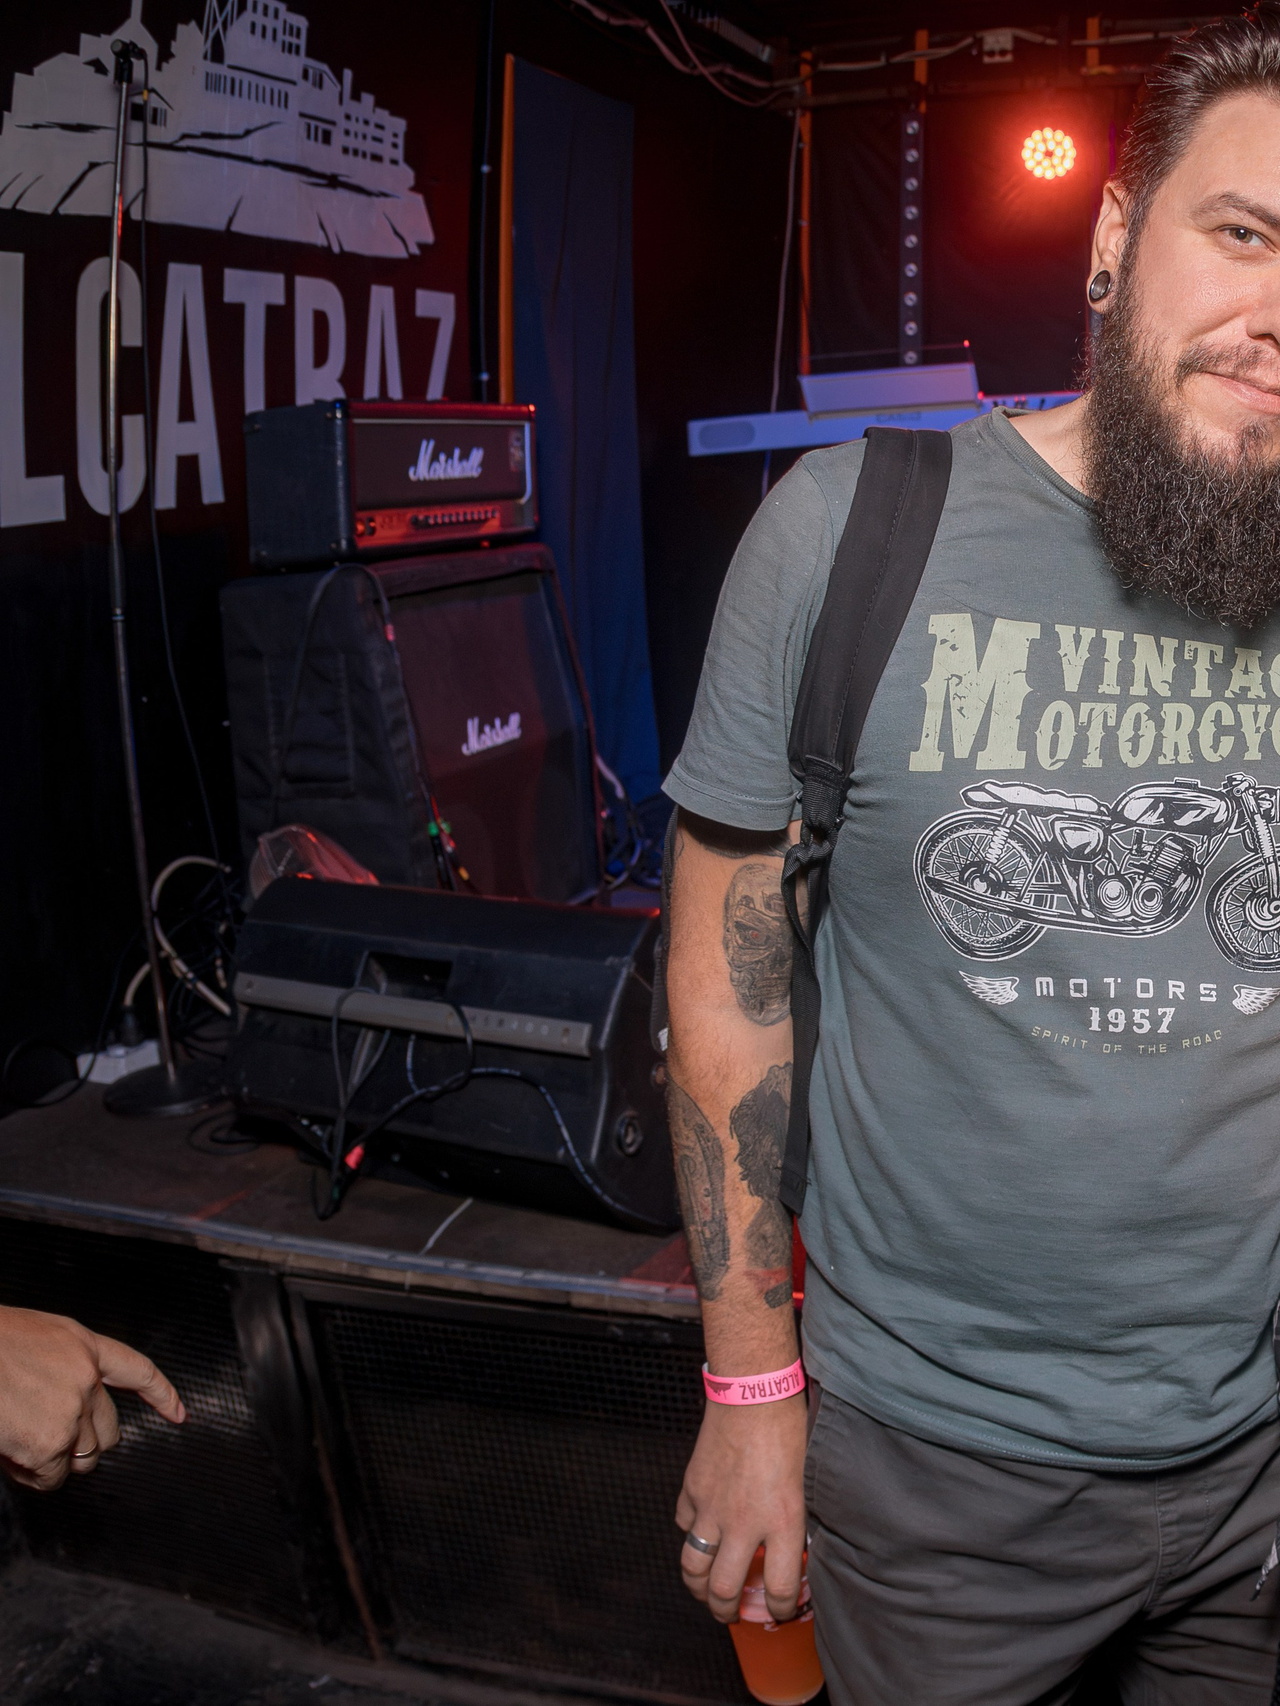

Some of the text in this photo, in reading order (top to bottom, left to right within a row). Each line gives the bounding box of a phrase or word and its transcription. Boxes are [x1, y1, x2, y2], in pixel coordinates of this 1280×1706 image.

[0, 251, 456, 528] LCATRAZ
[408, 437, 484, 482] Marshall
[461, 711, 522, 757] Marshall
[1035, 976, 1217, 1002] MOTORS
[1088, 1006, 1176, 1034] 1957
[1031, 1026, 1223, 1054] SPIRIT OF THE ROAD
[739, 1371, 800, 1400] ALCATRAZ
